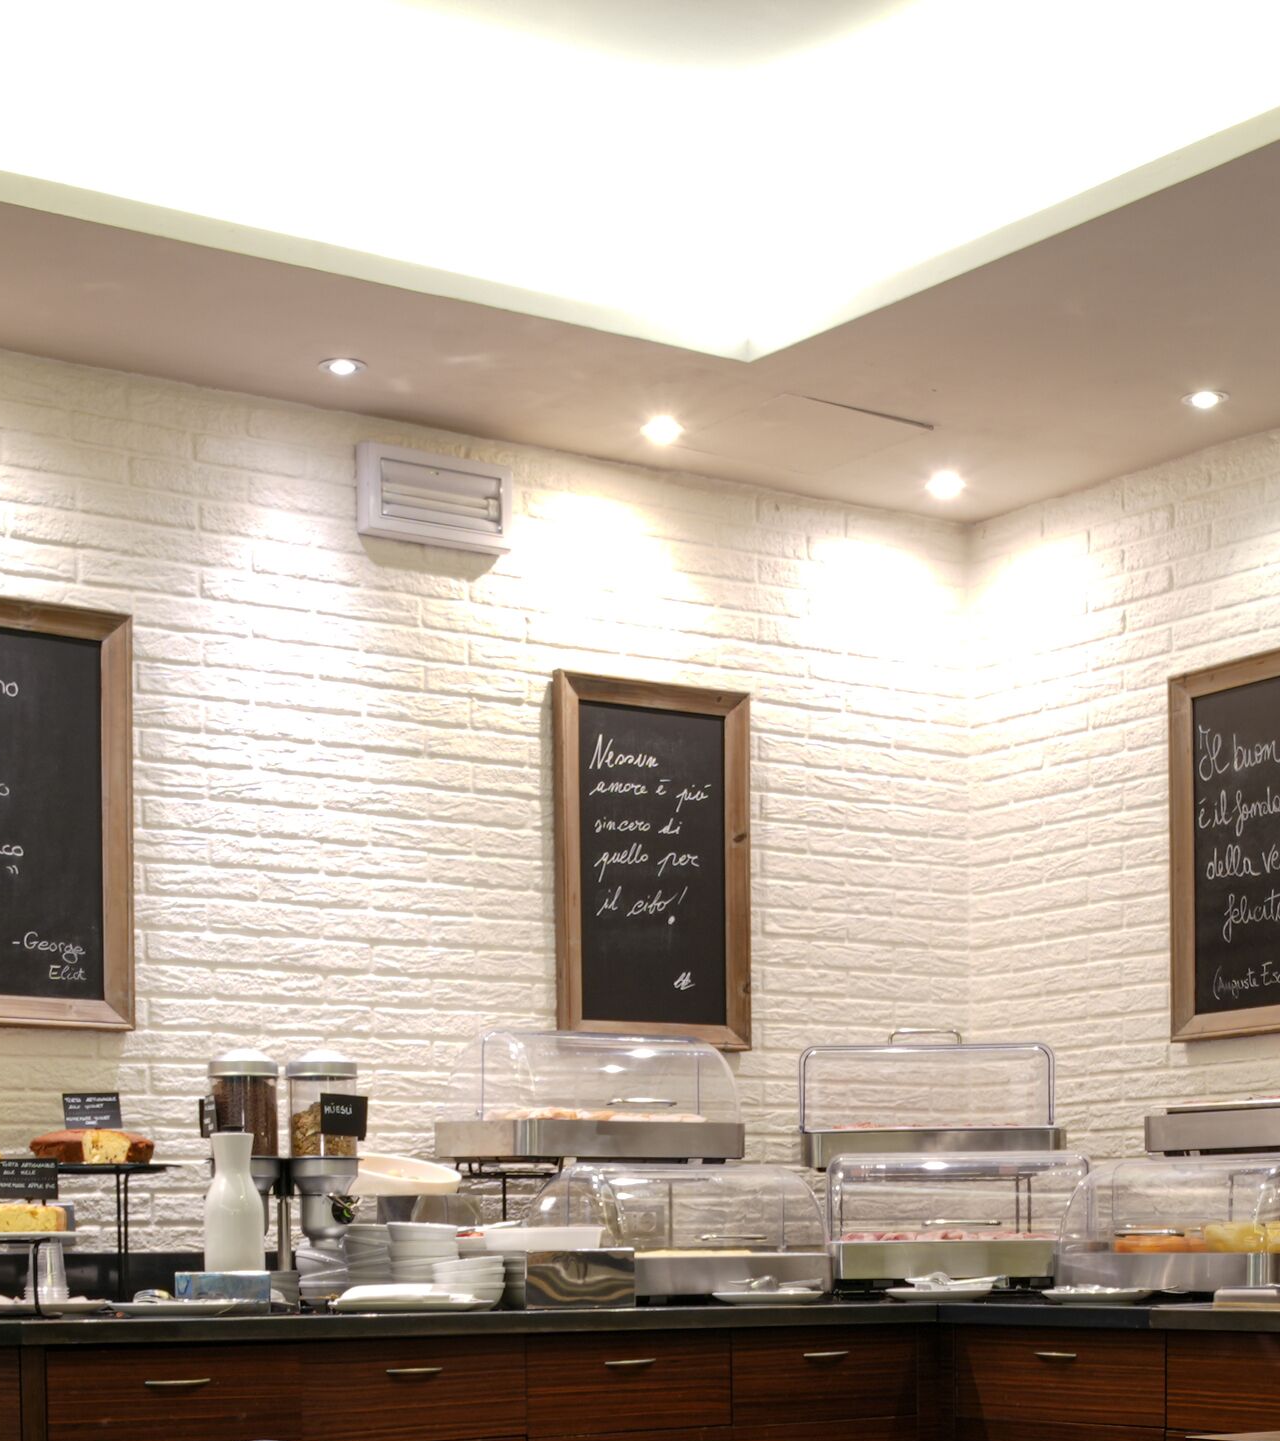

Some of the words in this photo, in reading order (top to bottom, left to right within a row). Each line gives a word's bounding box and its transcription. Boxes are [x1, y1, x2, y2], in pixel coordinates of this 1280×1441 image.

[588, 733, 660, 770] Nessun
[590, 780, 649, 797] amore
[594, 819, 652, 835] sincero
[657, 817, 681, 836] di
[1211, 788, 1233, 829] il
[594, 842, 650, 884] quello
[657, 851, 701, 878] per
[1205, 843, 1261, 881] della
[596, 886, 622, 917] il
